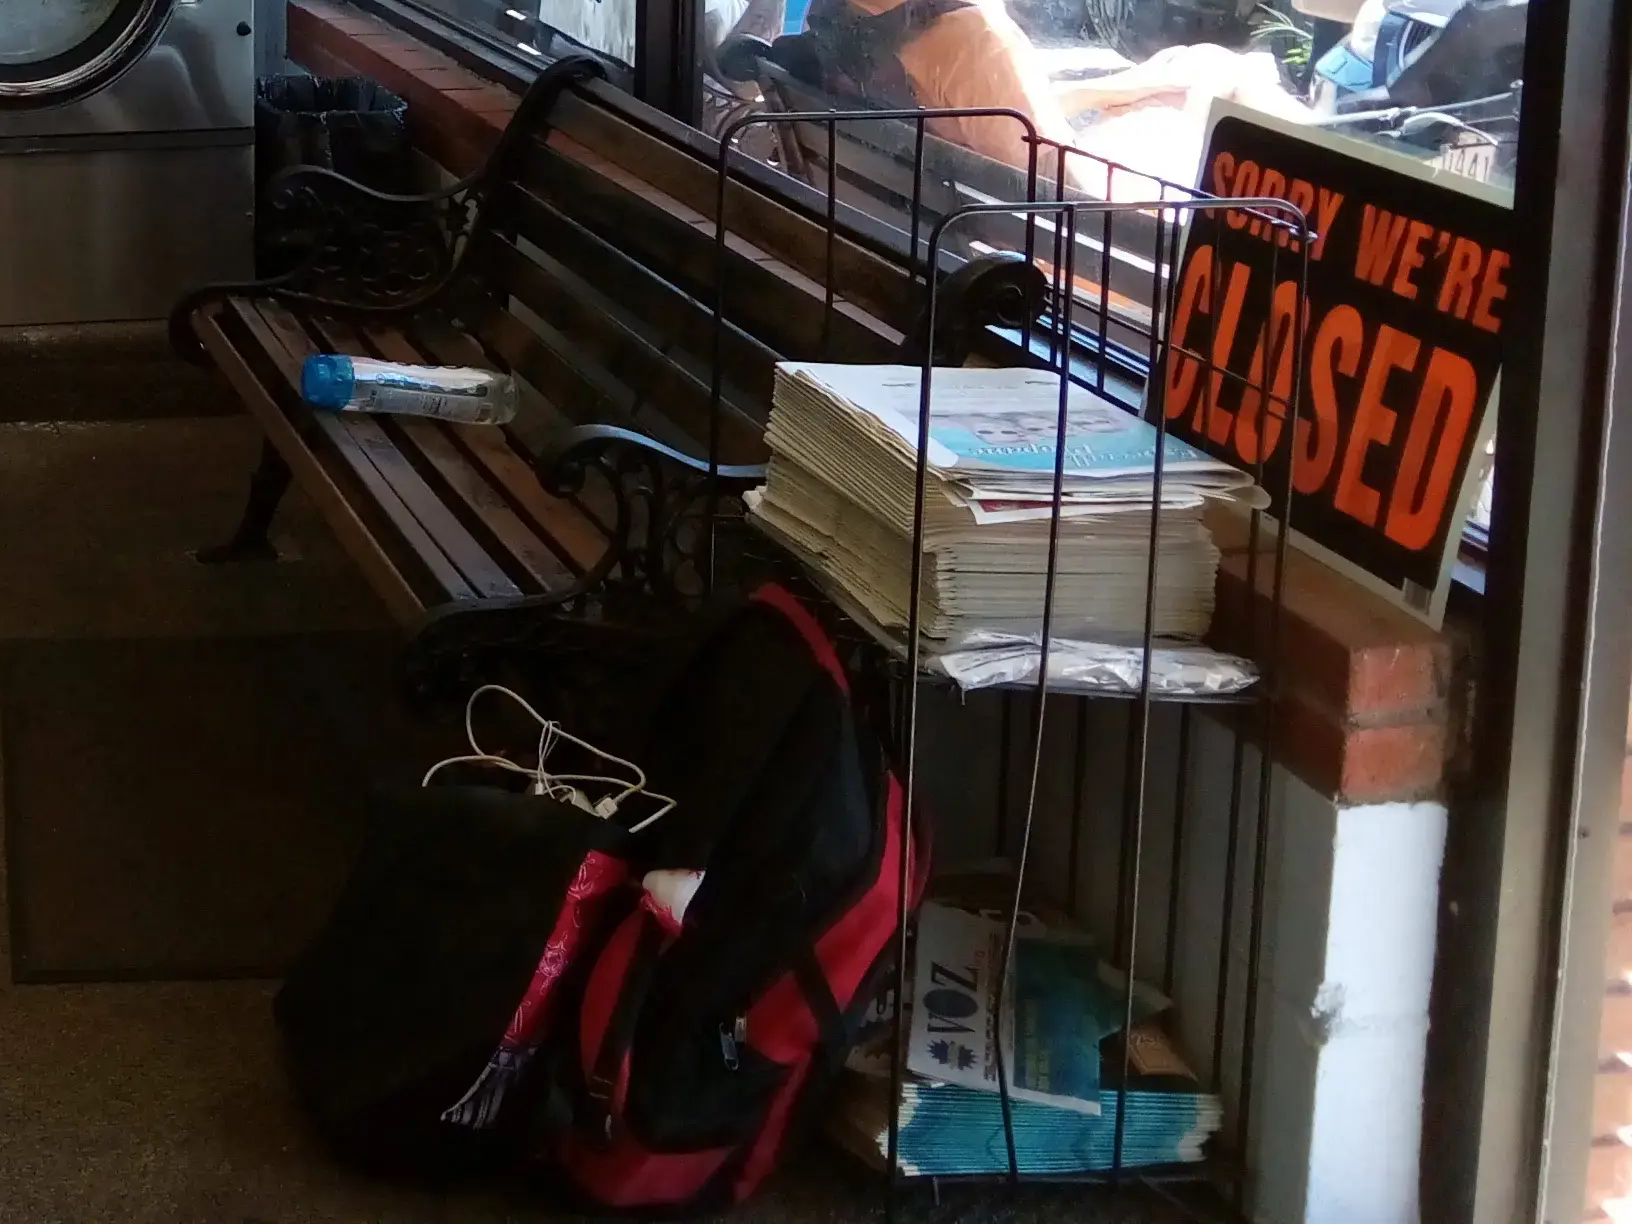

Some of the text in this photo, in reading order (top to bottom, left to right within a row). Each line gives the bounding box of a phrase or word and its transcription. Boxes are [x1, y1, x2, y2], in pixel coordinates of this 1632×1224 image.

[1203, 151, 1510, 333] SORRY WE'RE
[1165, 245, 1477, 551] CLOSED
